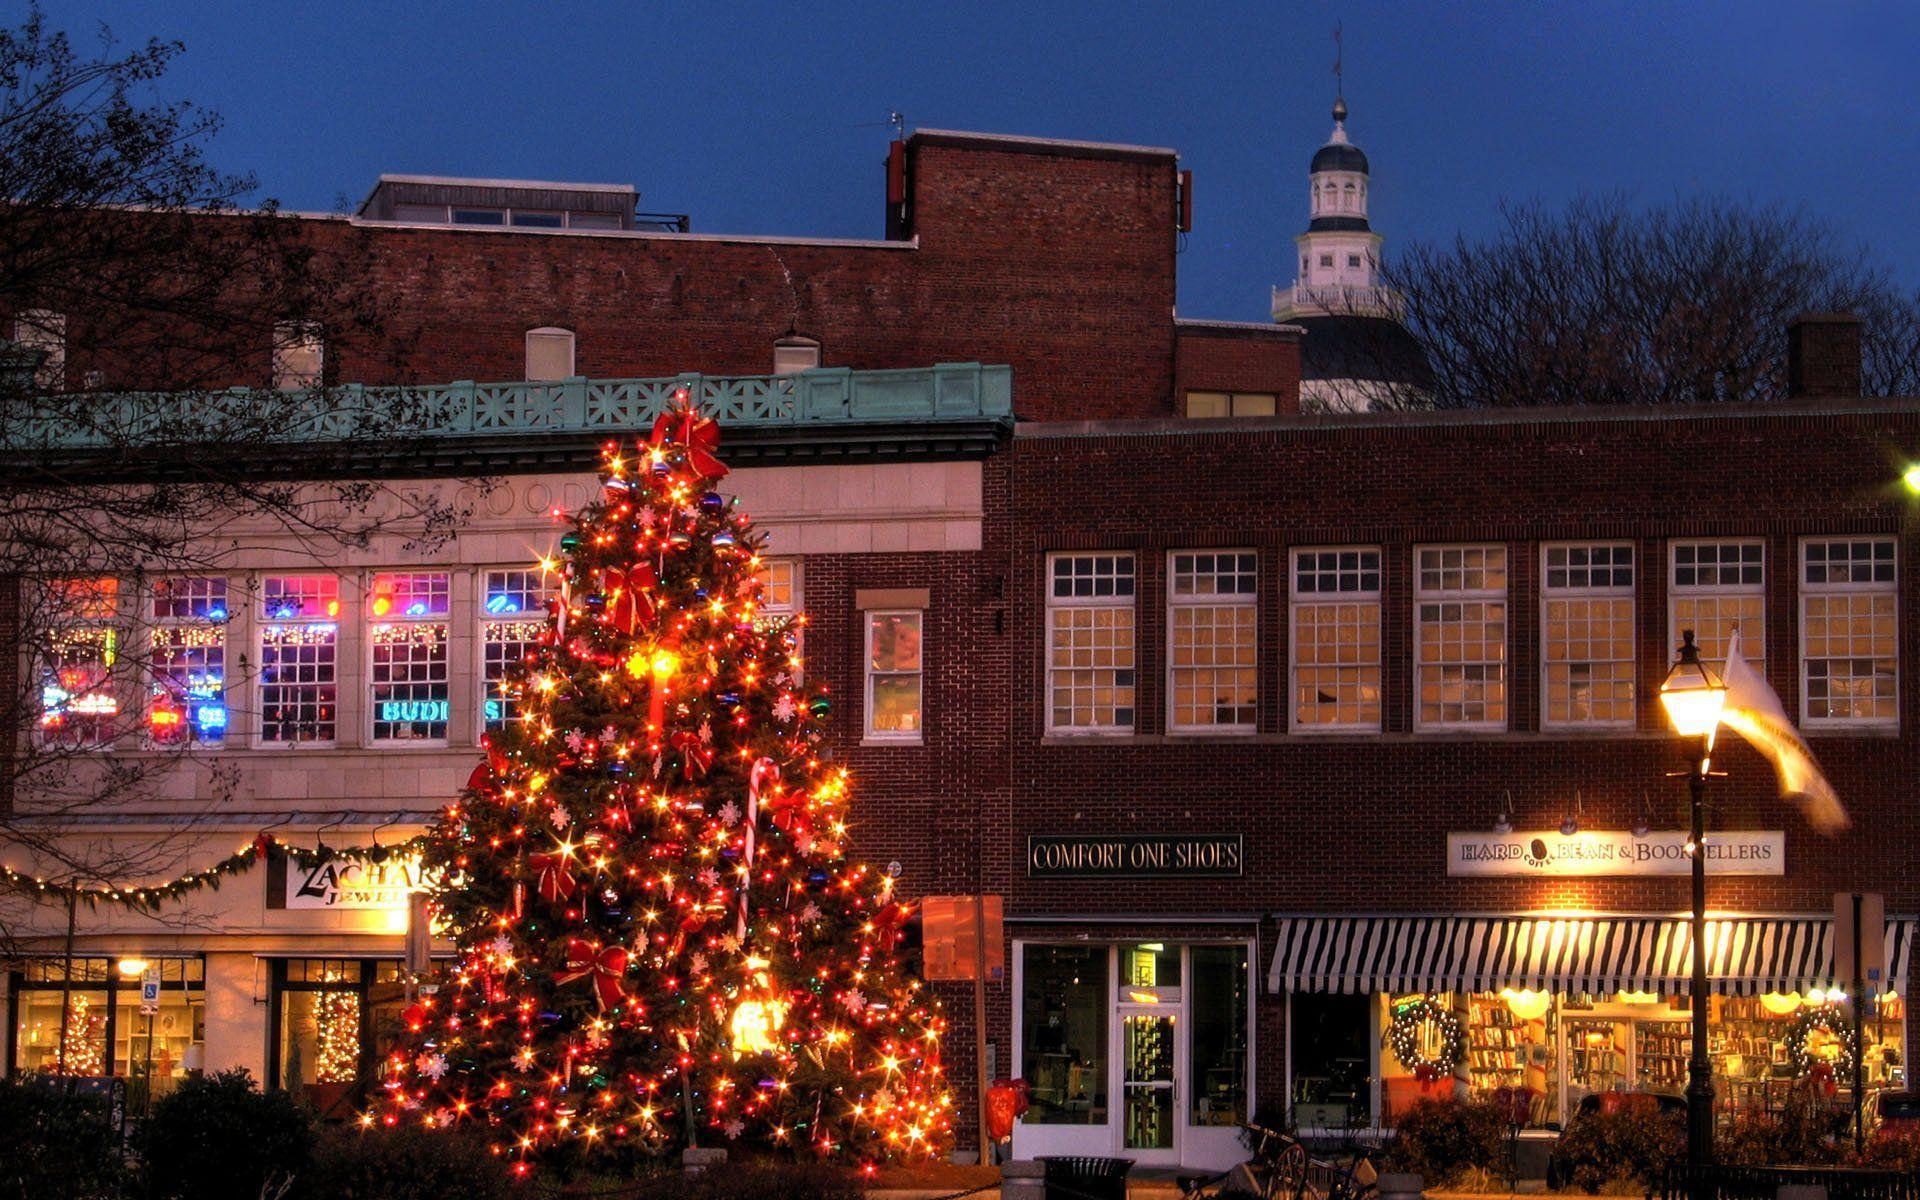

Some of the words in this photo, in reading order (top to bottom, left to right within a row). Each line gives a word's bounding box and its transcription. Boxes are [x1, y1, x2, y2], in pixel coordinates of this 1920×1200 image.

[1033, 842, 1127, 869] COMFORT
[1130, 842, 1171, 869] ONE
[1175, 842, 1238, 868] SHOES
[1461, 844, 1524, 861] HARD
[1557, 844, 1614, 860] BEAN
[1618, 845, 1633, 860] &
[1635, 843, 1772, 862] BOOKELLERS
